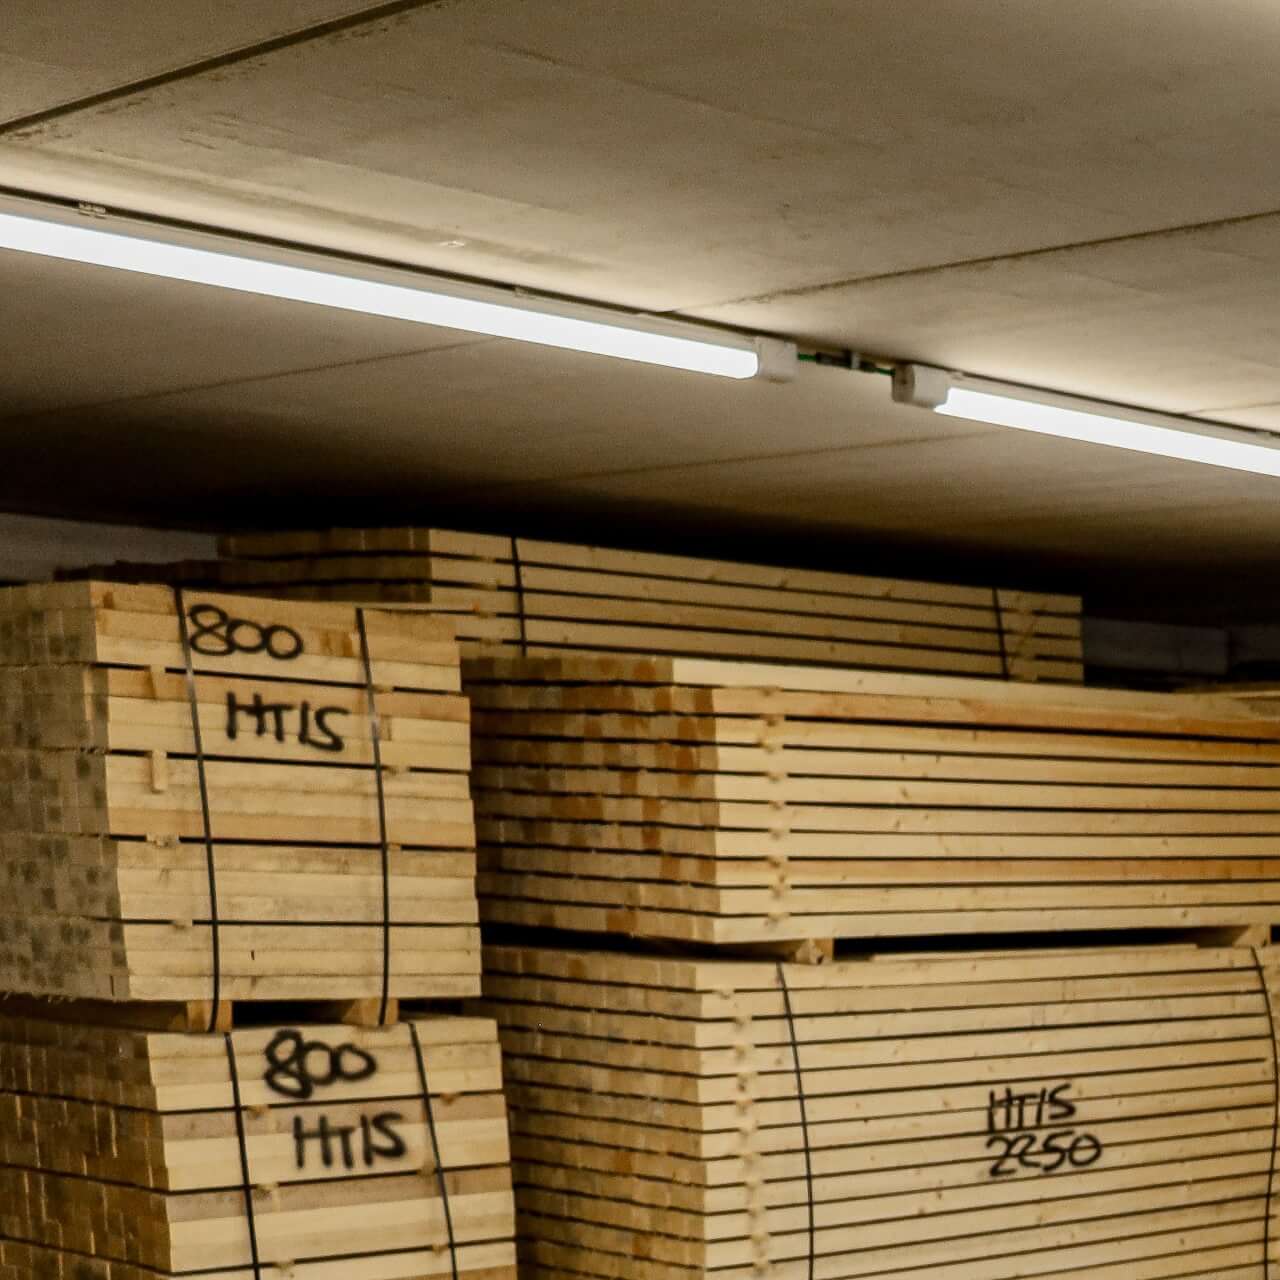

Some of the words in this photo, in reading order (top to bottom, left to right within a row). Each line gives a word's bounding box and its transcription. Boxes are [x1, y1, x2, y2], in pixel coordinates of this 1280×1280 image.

[189, 603, 304, 660] 800
[263, 1029, 378, 1099] 800
[985, 1130, 1103, 1176] 2250
